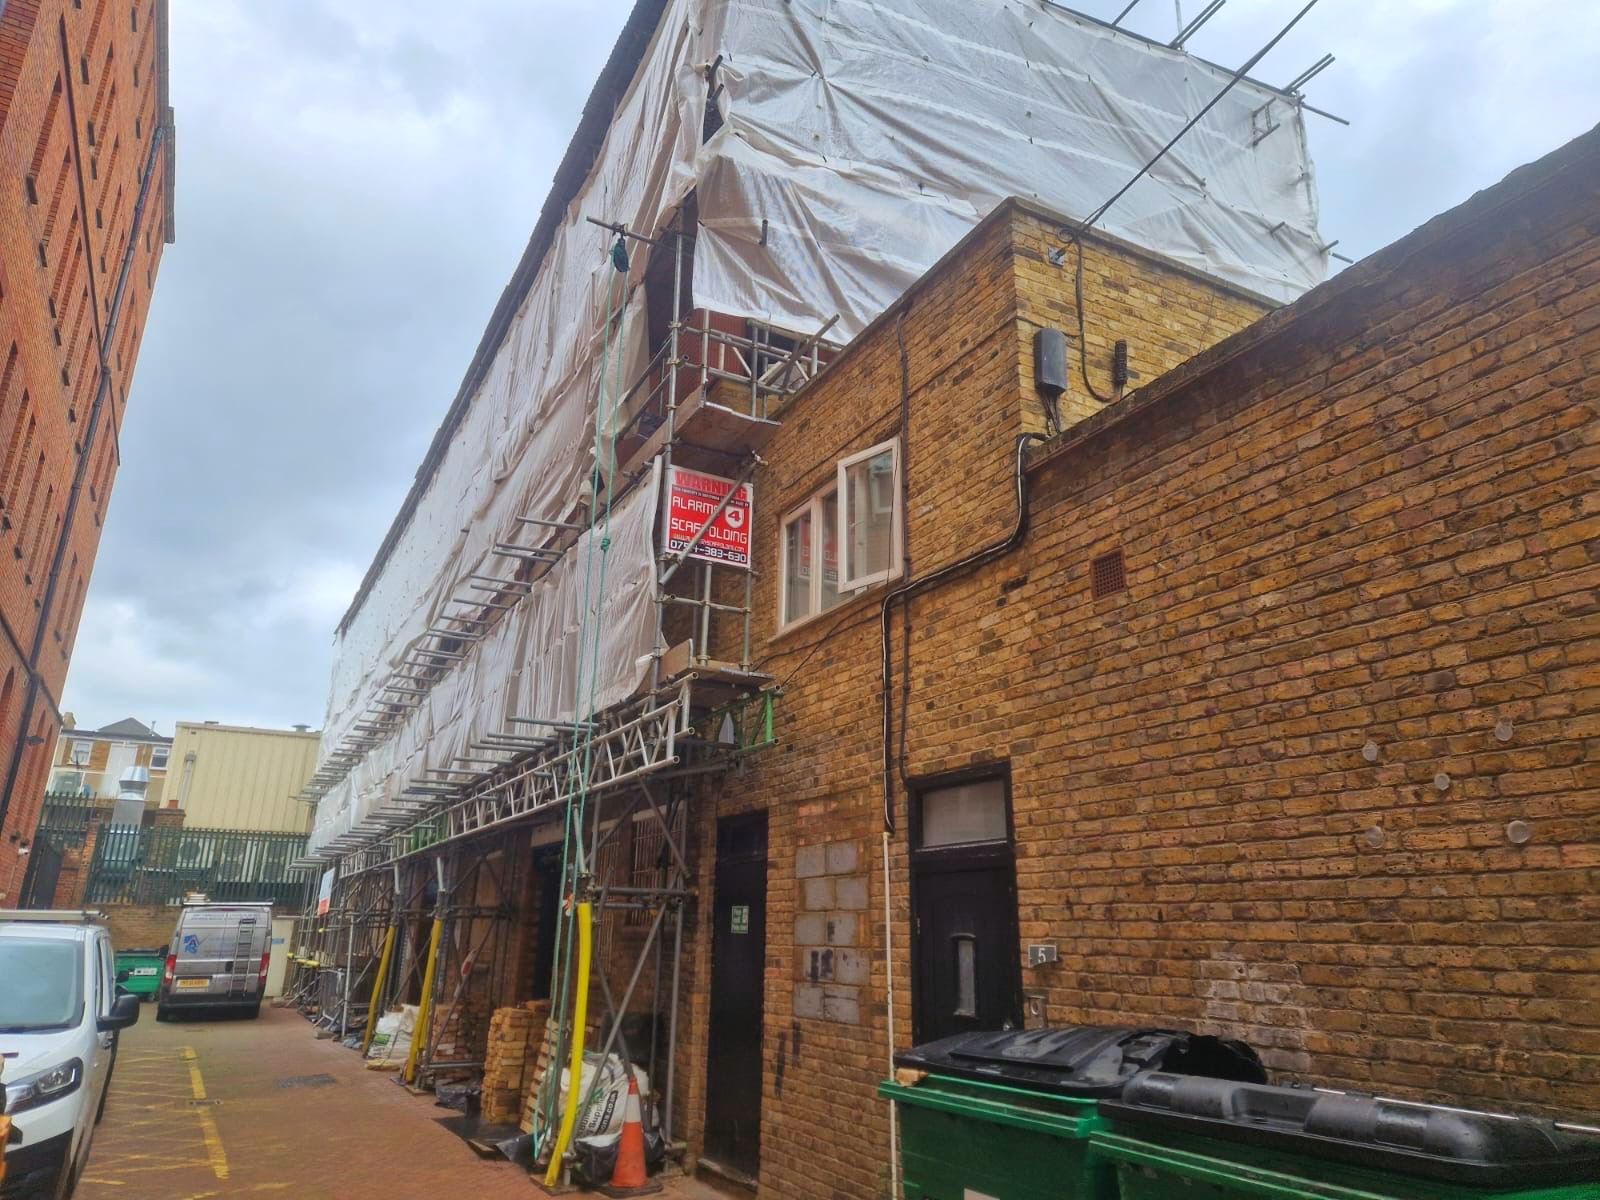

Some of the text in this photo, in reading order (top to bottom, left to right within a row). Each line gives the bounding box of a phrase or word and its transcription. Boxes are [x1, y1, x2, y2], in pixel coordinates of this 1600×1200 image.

[674, 471, 748, 502] WARNIG
[727, 510, 741, 522] 4
[671, 517, 747, 545] SCAFOLDING
[1038, 947, 1047, 964] 5
